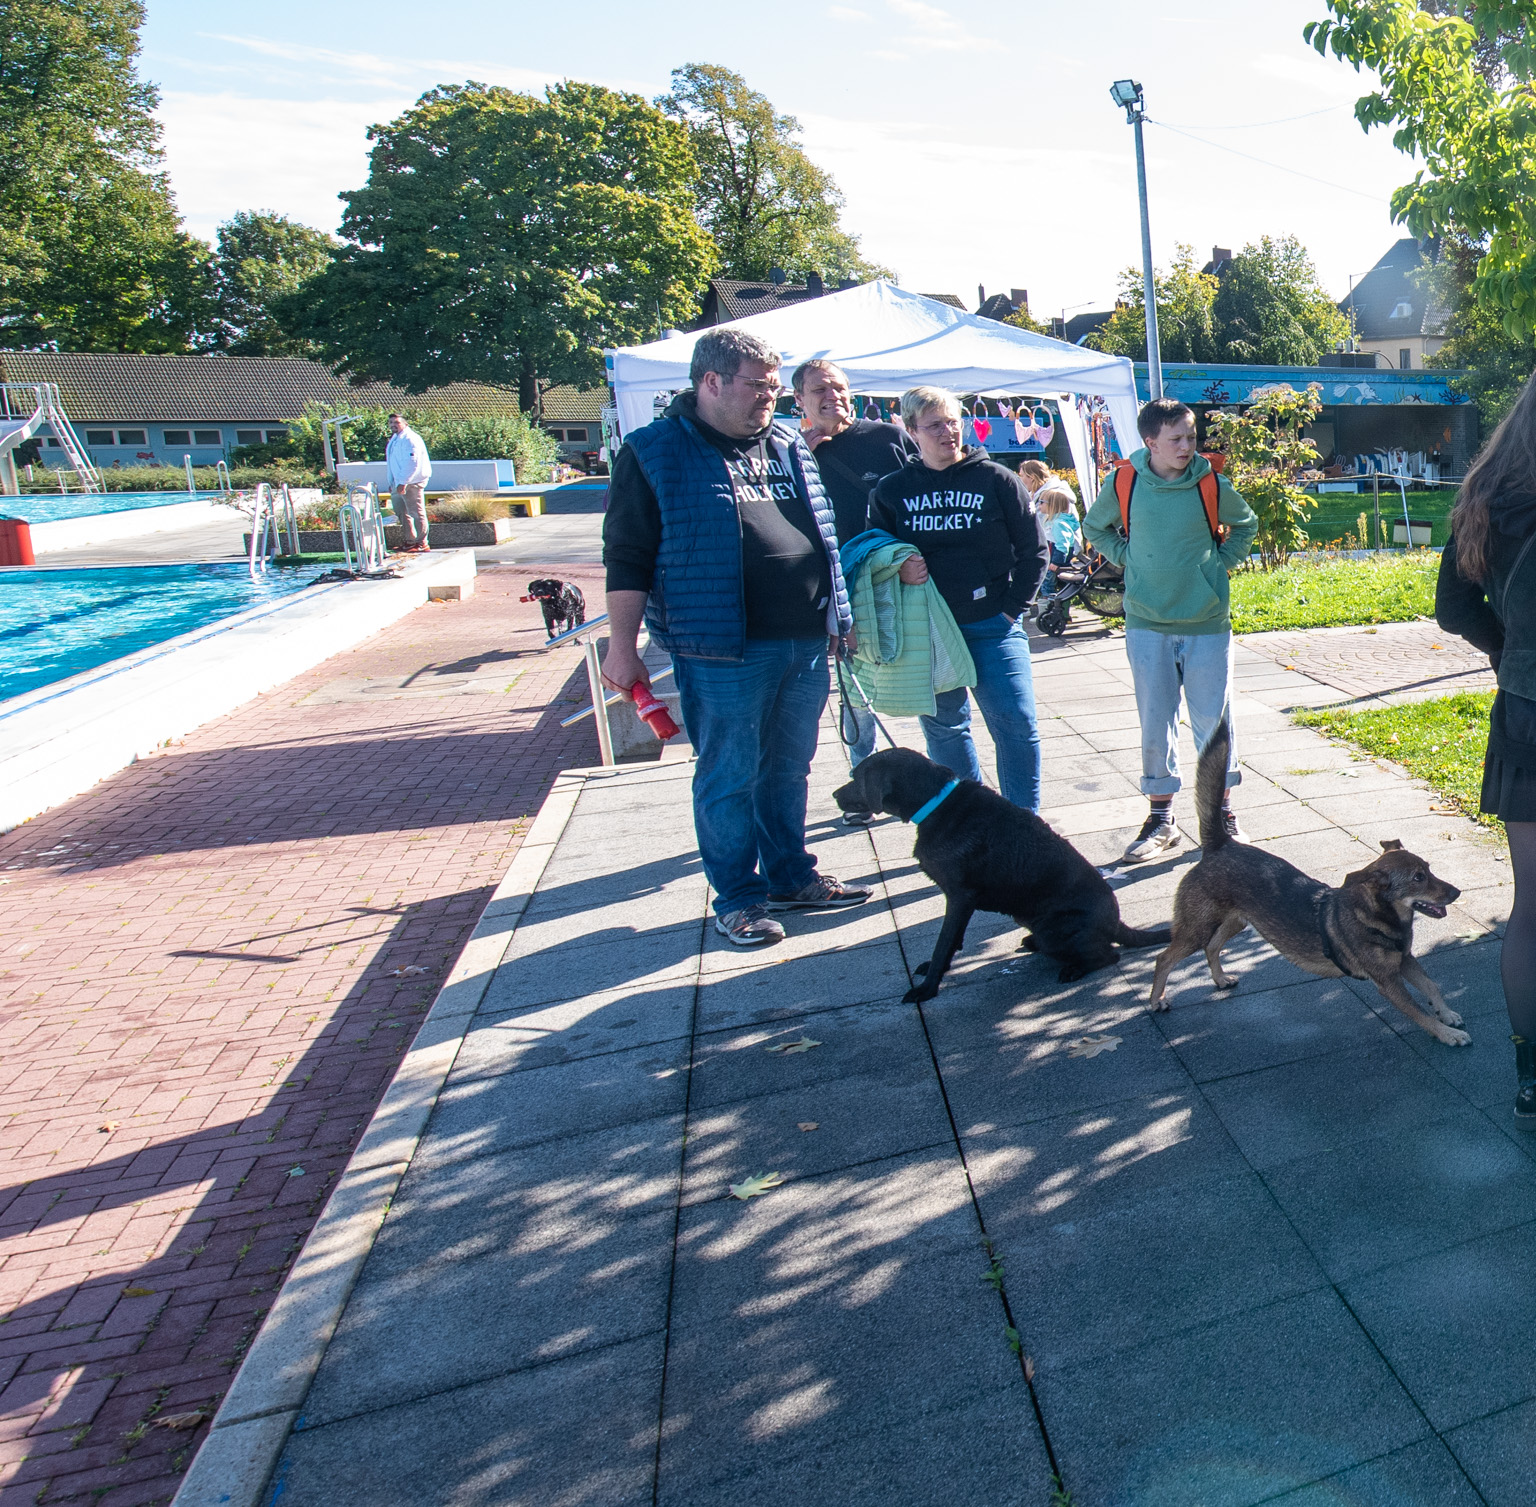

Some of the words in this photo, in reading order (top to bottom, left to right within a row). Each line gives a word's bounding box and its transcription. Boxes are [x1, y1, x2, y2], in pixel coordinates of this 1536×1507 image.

[724, 459, 789, 479] ARRIO
[735, 483, 798, 503] HOCKEY
[902, 490, 985, 512] WARRIOR
[912, 513, 975, 531] HOCKEY
